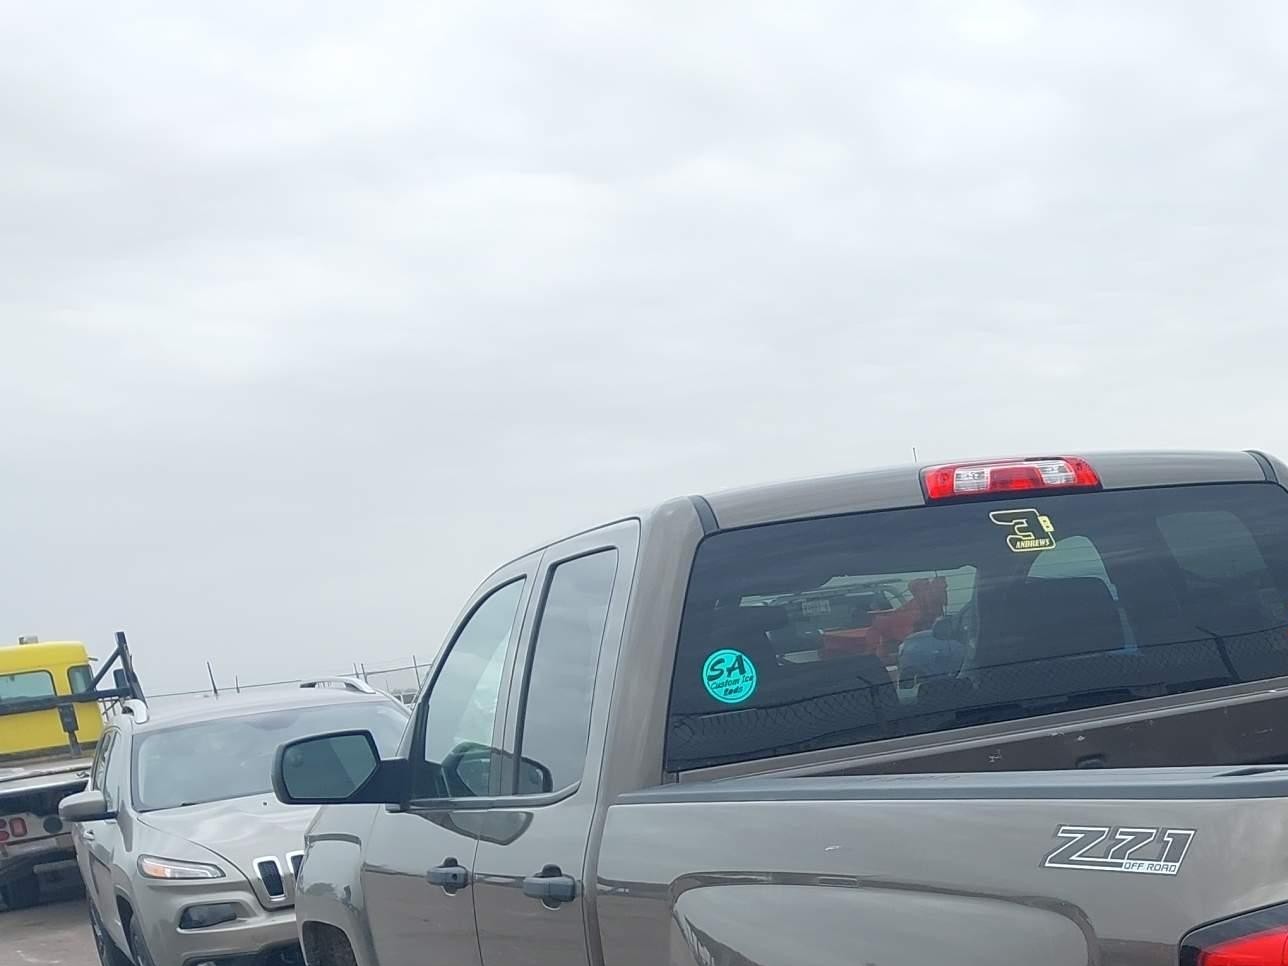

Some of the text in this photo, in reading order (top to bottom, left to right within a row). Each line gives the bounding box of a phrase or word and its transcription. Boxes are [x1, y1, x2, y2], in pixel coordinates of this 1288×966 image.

[1015, 538, 1051, 549] ANDREWS
[706, 654, 747, 682] SA
[1042, 825, 1196, 875] Z71
[1123, 861, 1177, 873] OFF ROAD
